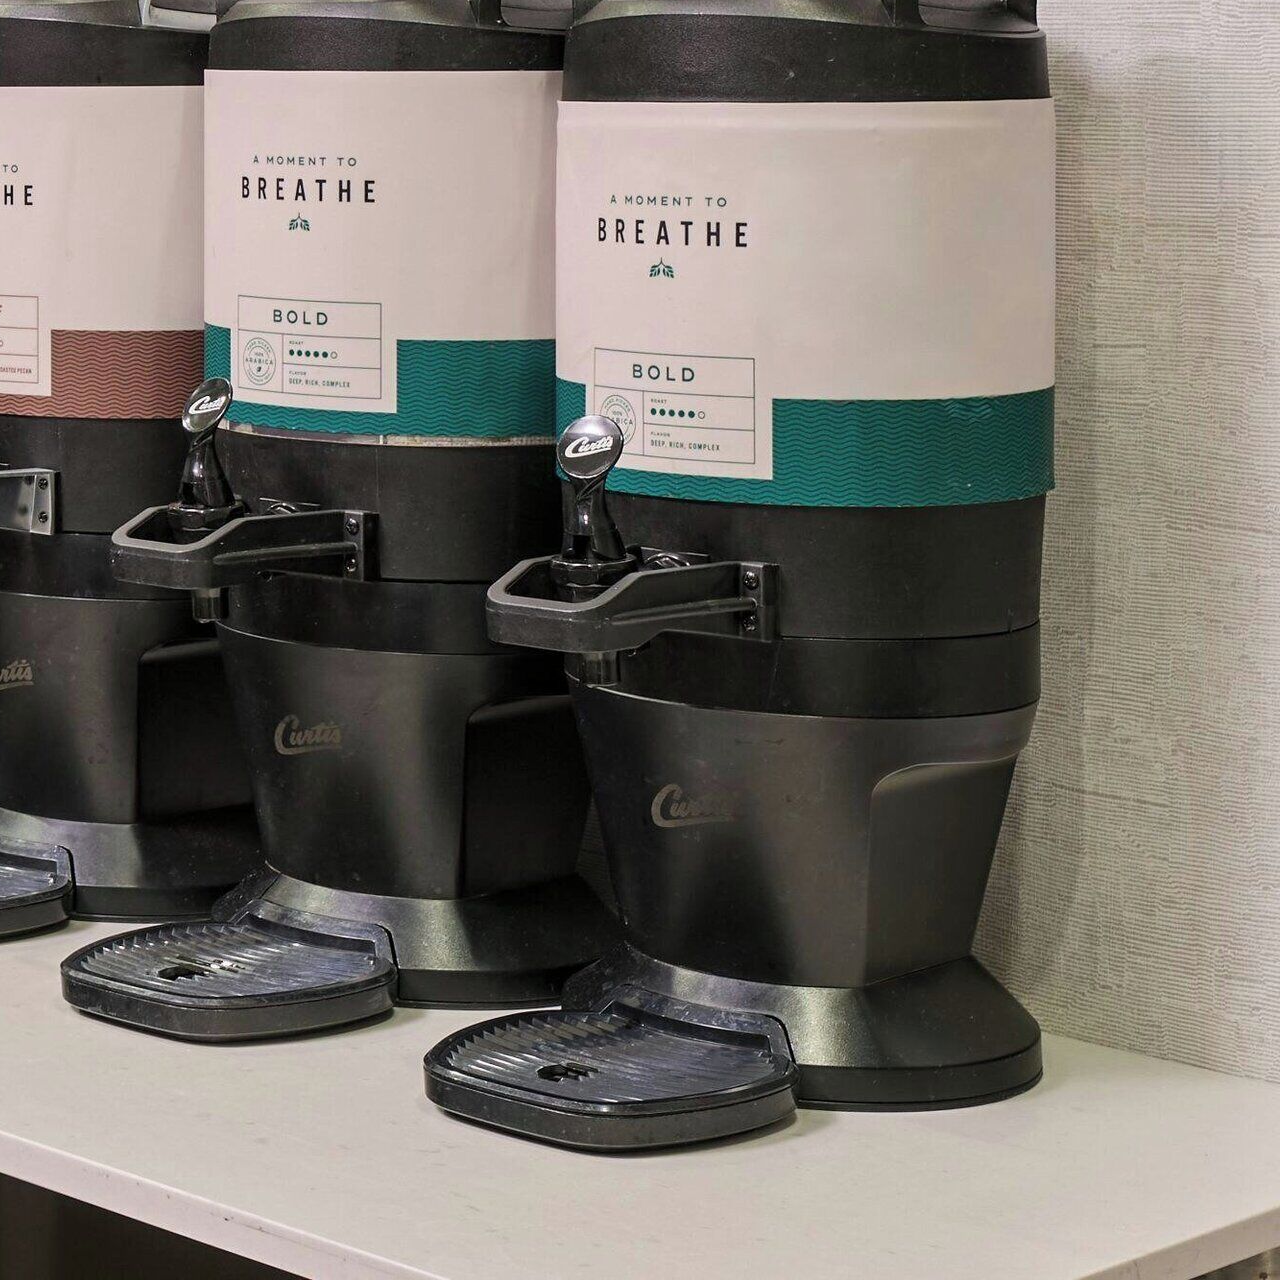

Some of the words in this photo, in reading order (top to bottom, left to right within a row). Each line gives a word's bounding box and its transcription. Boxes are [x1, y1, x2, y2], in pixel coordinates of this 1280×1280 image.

[3, 164, 19, 174] TO
[253, 155, 260, 165] A
[266, 155, 327, 167] MOMENT
[337, 157, 358, 168] TO
[241, 176, 376, 203] BREATHE
[610, 194, 617, 205] A
[624, 195, 694, 208] MOMENT
[705, 196, 728, 208] TO
[597, 217, 749, 248] BREATHE
[273, 308, 329, 327] BOLD
[632, 363, 696, 383] BOLD
[650, 439, 668, 448] DEEP,
[669, 441, 687, 450] RICH,
[688, 442, 720, 451] COMPLEX
[273, 713, 342, 756] Curtis
